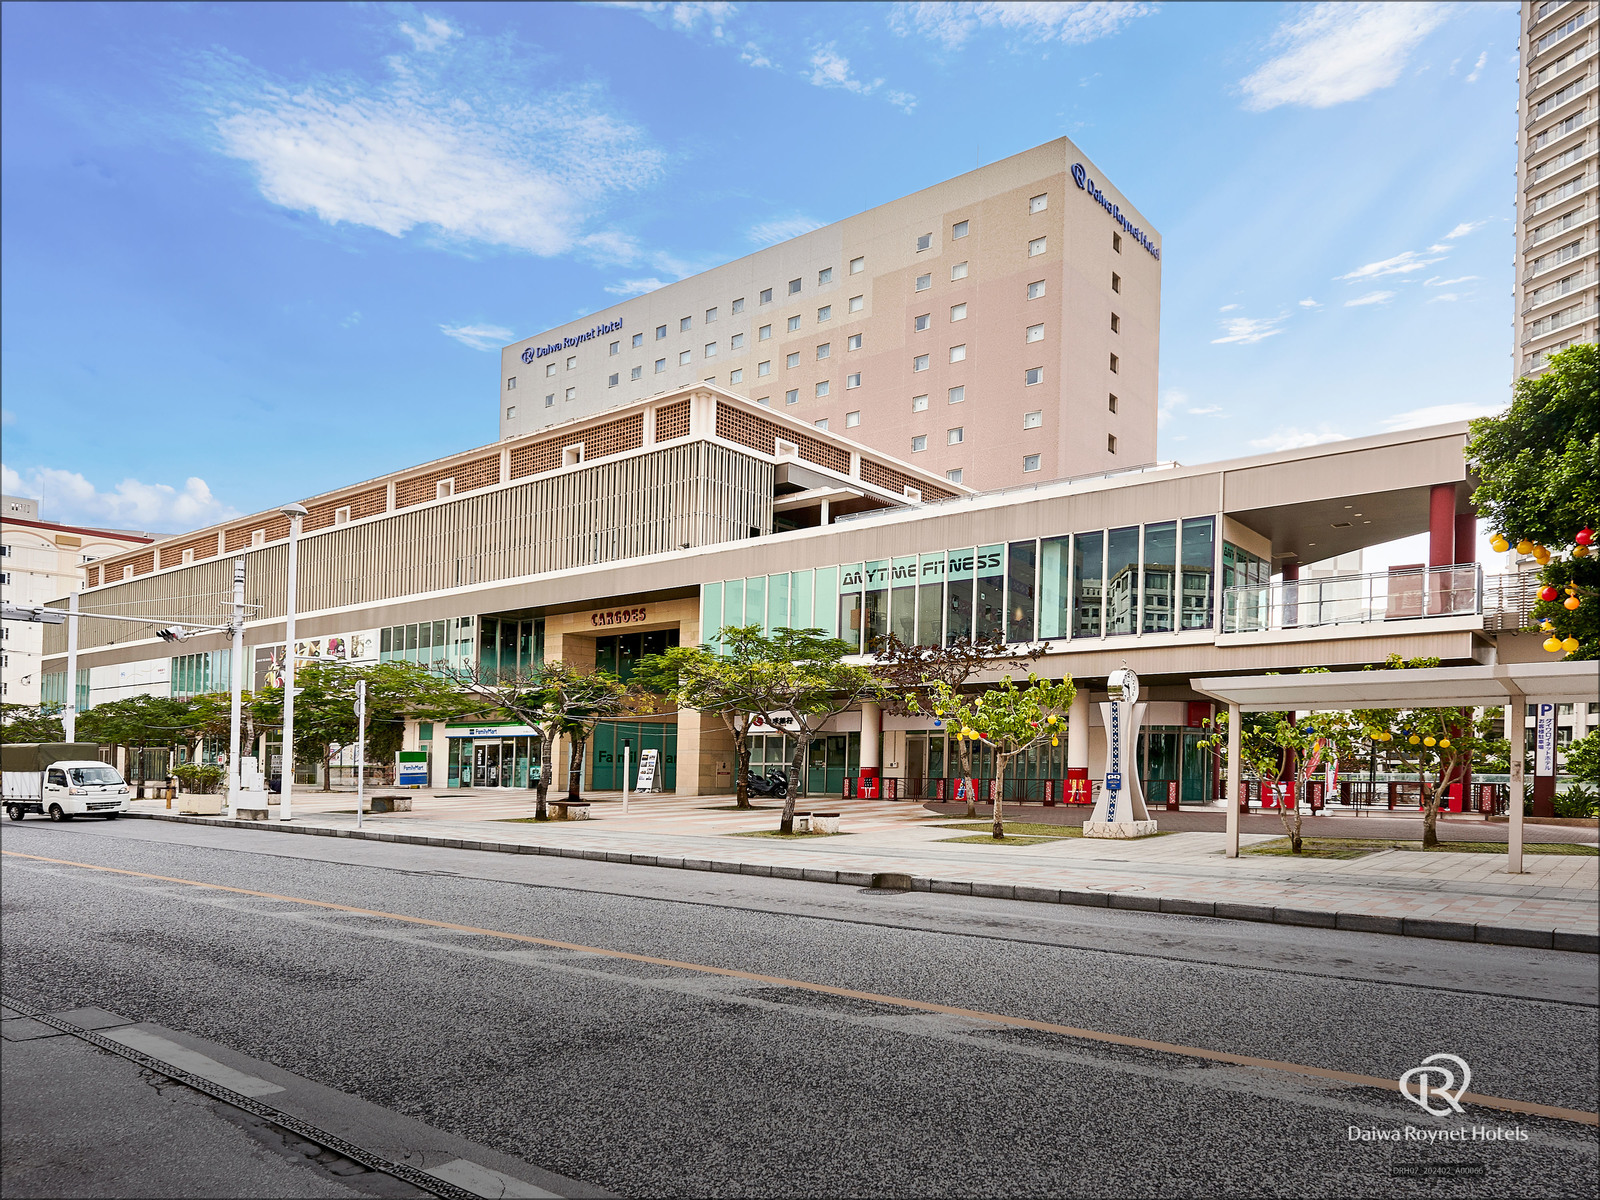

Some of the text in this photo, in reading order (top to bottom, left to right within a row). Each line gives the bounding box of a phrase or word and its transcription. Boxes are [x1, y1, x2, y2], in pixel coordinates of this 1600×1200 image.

[1087, 178, 1160, 261] Daiwa Roynet Hotel
[536, 318, 623, 358] Daiwa Roynet Hotel
[843, 553, 1001, 586] ANYTIME FITNESS
[591, 607, 647, 627] CARGOES
[1541, 704, 1553, 716] P
